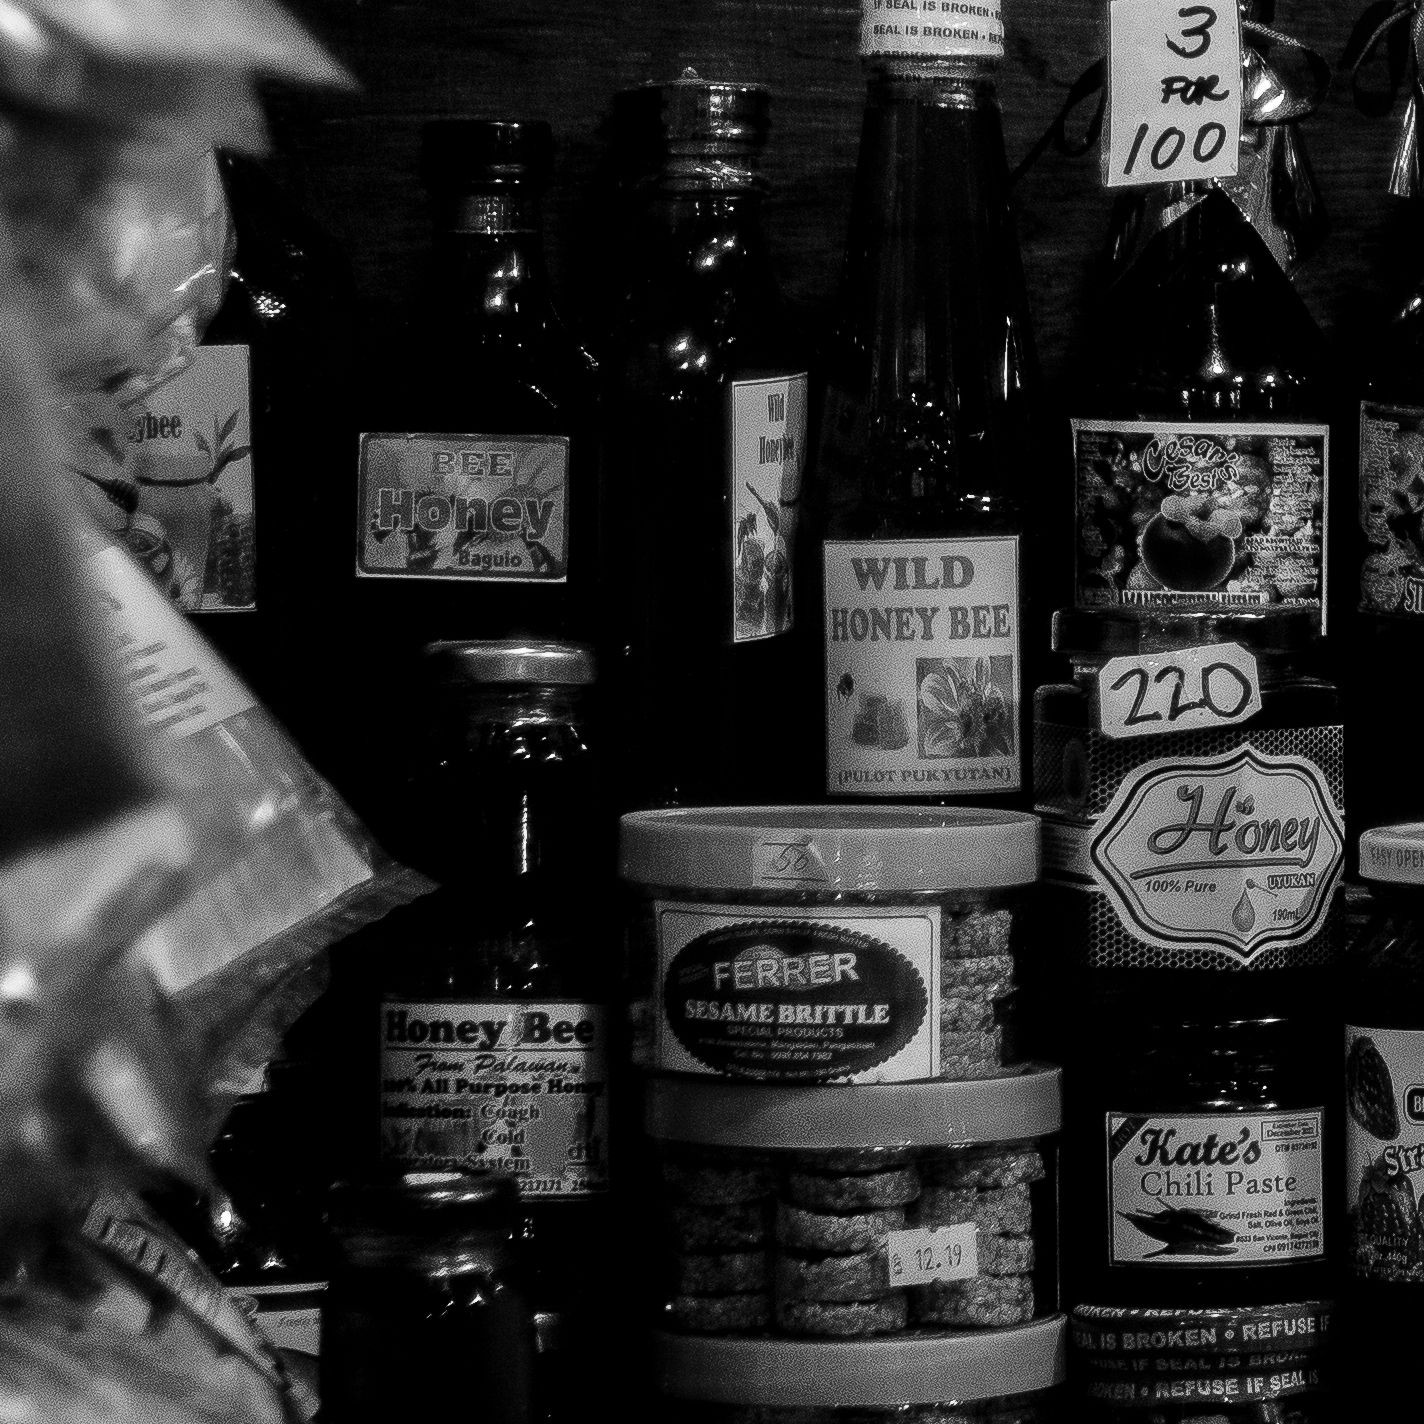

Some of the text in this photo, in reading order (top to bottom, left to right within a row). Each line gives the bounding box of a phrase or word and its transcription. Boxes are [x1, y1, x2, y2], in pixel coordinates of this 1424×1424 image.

[905, 25, 918, 36] IS
[923, 26, 978, 40] BROKEN
[1165, 4, 1217, 60] 3
[1160, 74, 1230, 105] FOR
[1122, 120, 1228, 177] 100
[431, 449, 515, 477] BEE
[378, 487, 556, 542] Honey
[851, 555, 975, 591] WILD
[829, 604, 1011, 642] HONEY BEE
[1109, 660, 1254, 726] 220
[1147, 782, 1321, 867] Honey
[1144, 878, 1217, 895] 100% Pure
[713, 952, 860, 992] FERRER
[386, 1009, 596, 1050] Honey Bee
[684, 999, 890, 1025] SESAME BRITTLE
[481, 1128, 526, 1146] Cold
[1135, 1126, 1262, 1166] Kate's
[1140, 1170, 1297, 1197] Chili Paste
